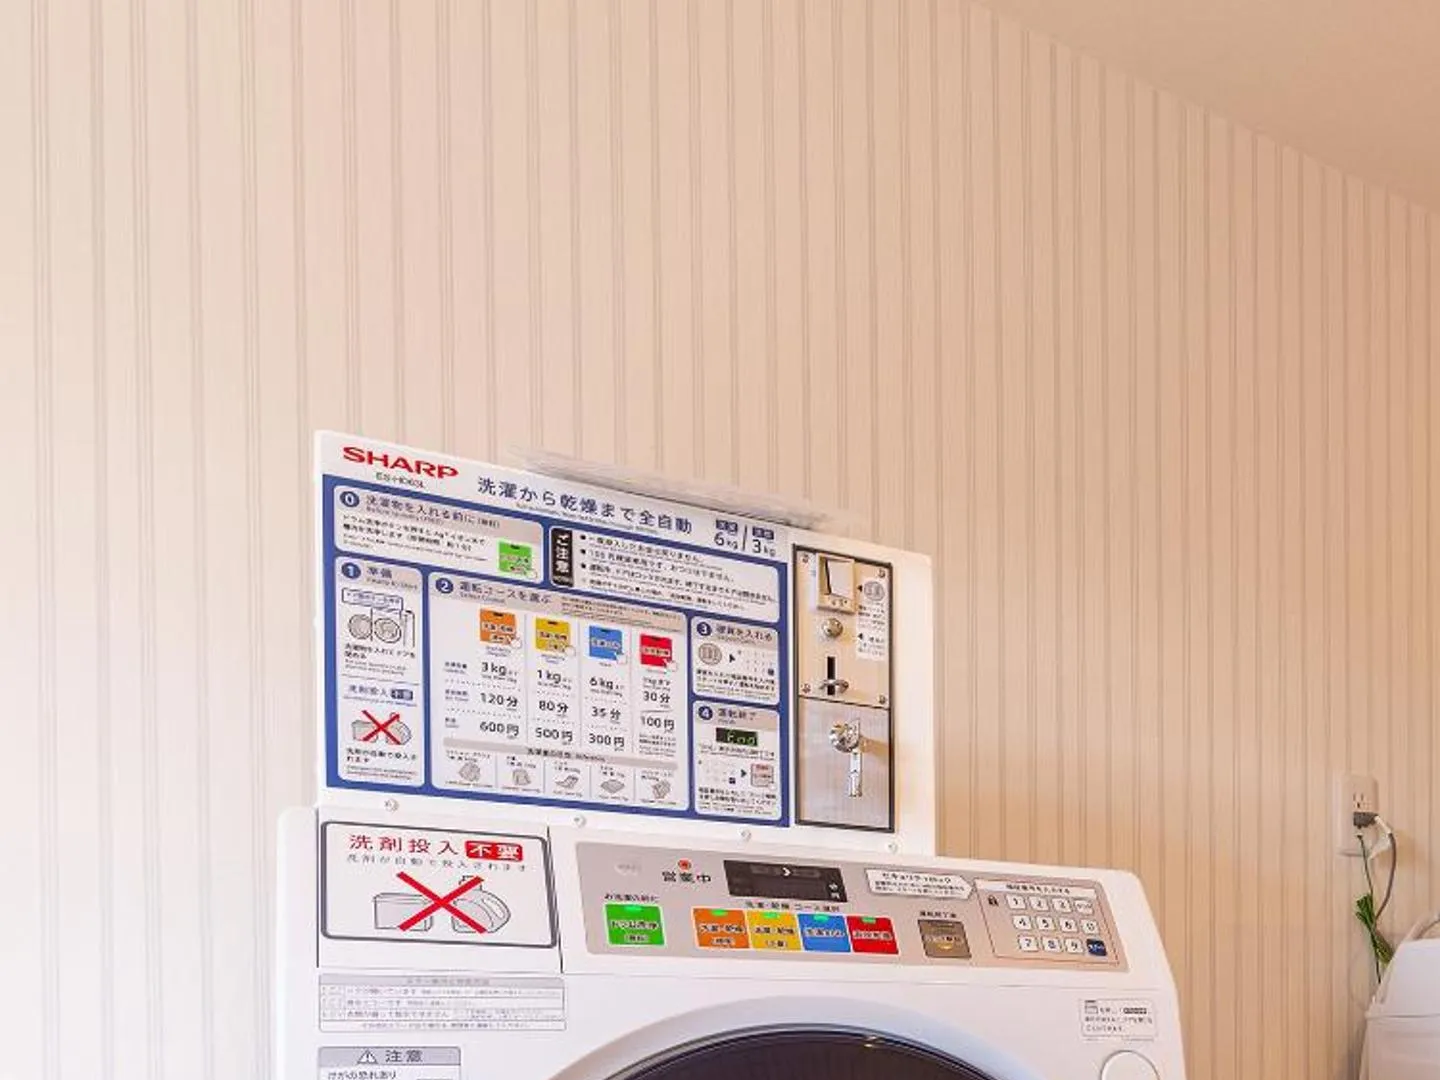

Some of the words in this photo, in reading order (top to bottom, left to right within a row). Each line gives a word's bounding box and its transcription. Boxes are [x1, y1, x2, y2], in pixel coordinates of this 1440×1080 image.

[343, 447, 459, 479] SHARP
[477, 476, 693, 535] 洗濯から乾燥まで全自動
[480, 692, 518, 708] 120分
[643, 691, 670, 704] 30分
[539, 700, 568, 714] 80分
[591, 706, 621, 720] 35分
[480, 722, 519, 737] 600円
[641, 716, 675, 731] 100円
[535, 727, 573, 742] 500円
[589, 733, 625, 748] 300円
[349, 834, 460, 855] 洗剤投入
[470, 843, 520, 860] 不要
[662, 871, 711, 883] 営業中
[385, 1049, 422, 1063] 注意
